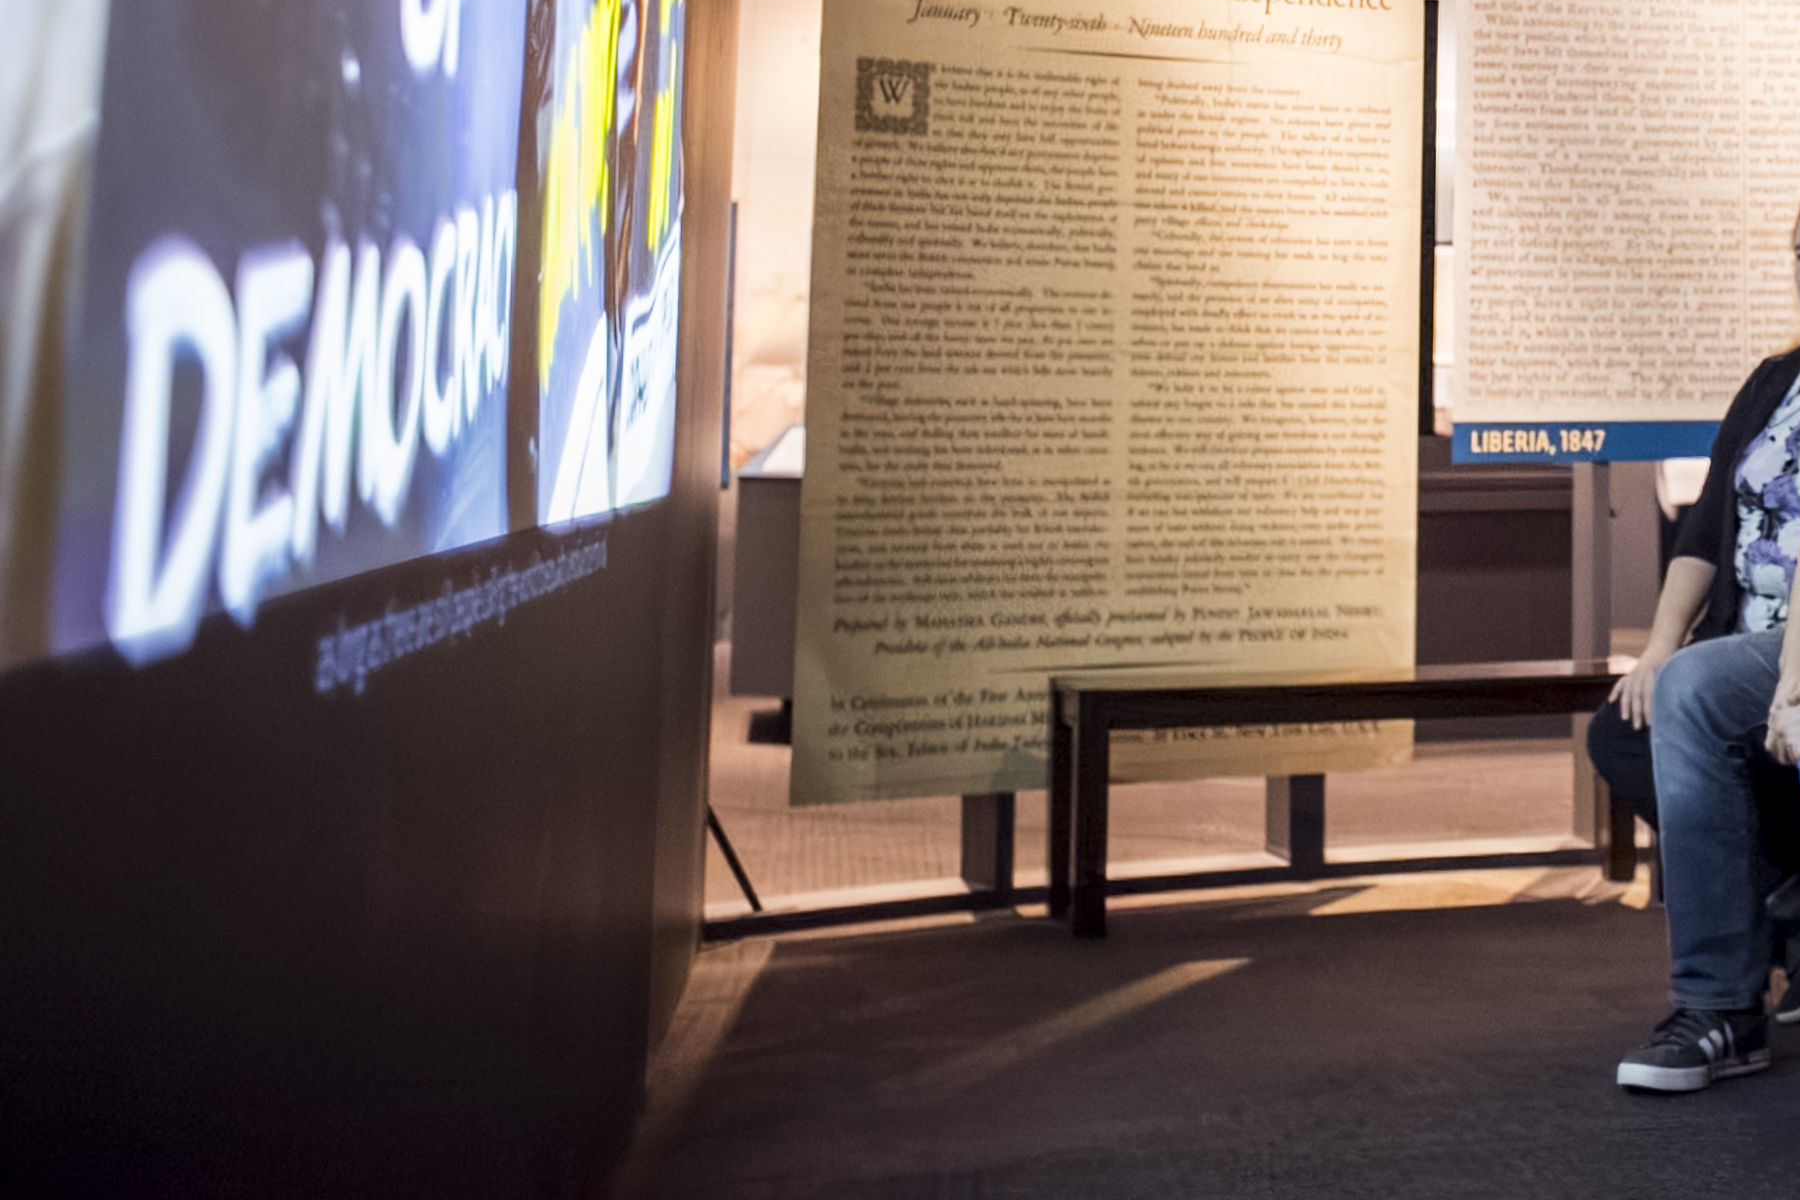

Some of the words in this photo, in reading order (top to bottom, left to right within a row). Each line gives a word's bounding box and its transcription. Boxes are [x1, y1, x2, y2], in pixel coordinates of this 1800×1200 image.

[1197, 20, 1265, 44] hundred
[1265, 26, 1300, 46] and
[1300, 26, 1343, 55] thirty
[1470, 429, 1557, 456] LIBERIA,
[1559, 429, 1606, 453] 1847
